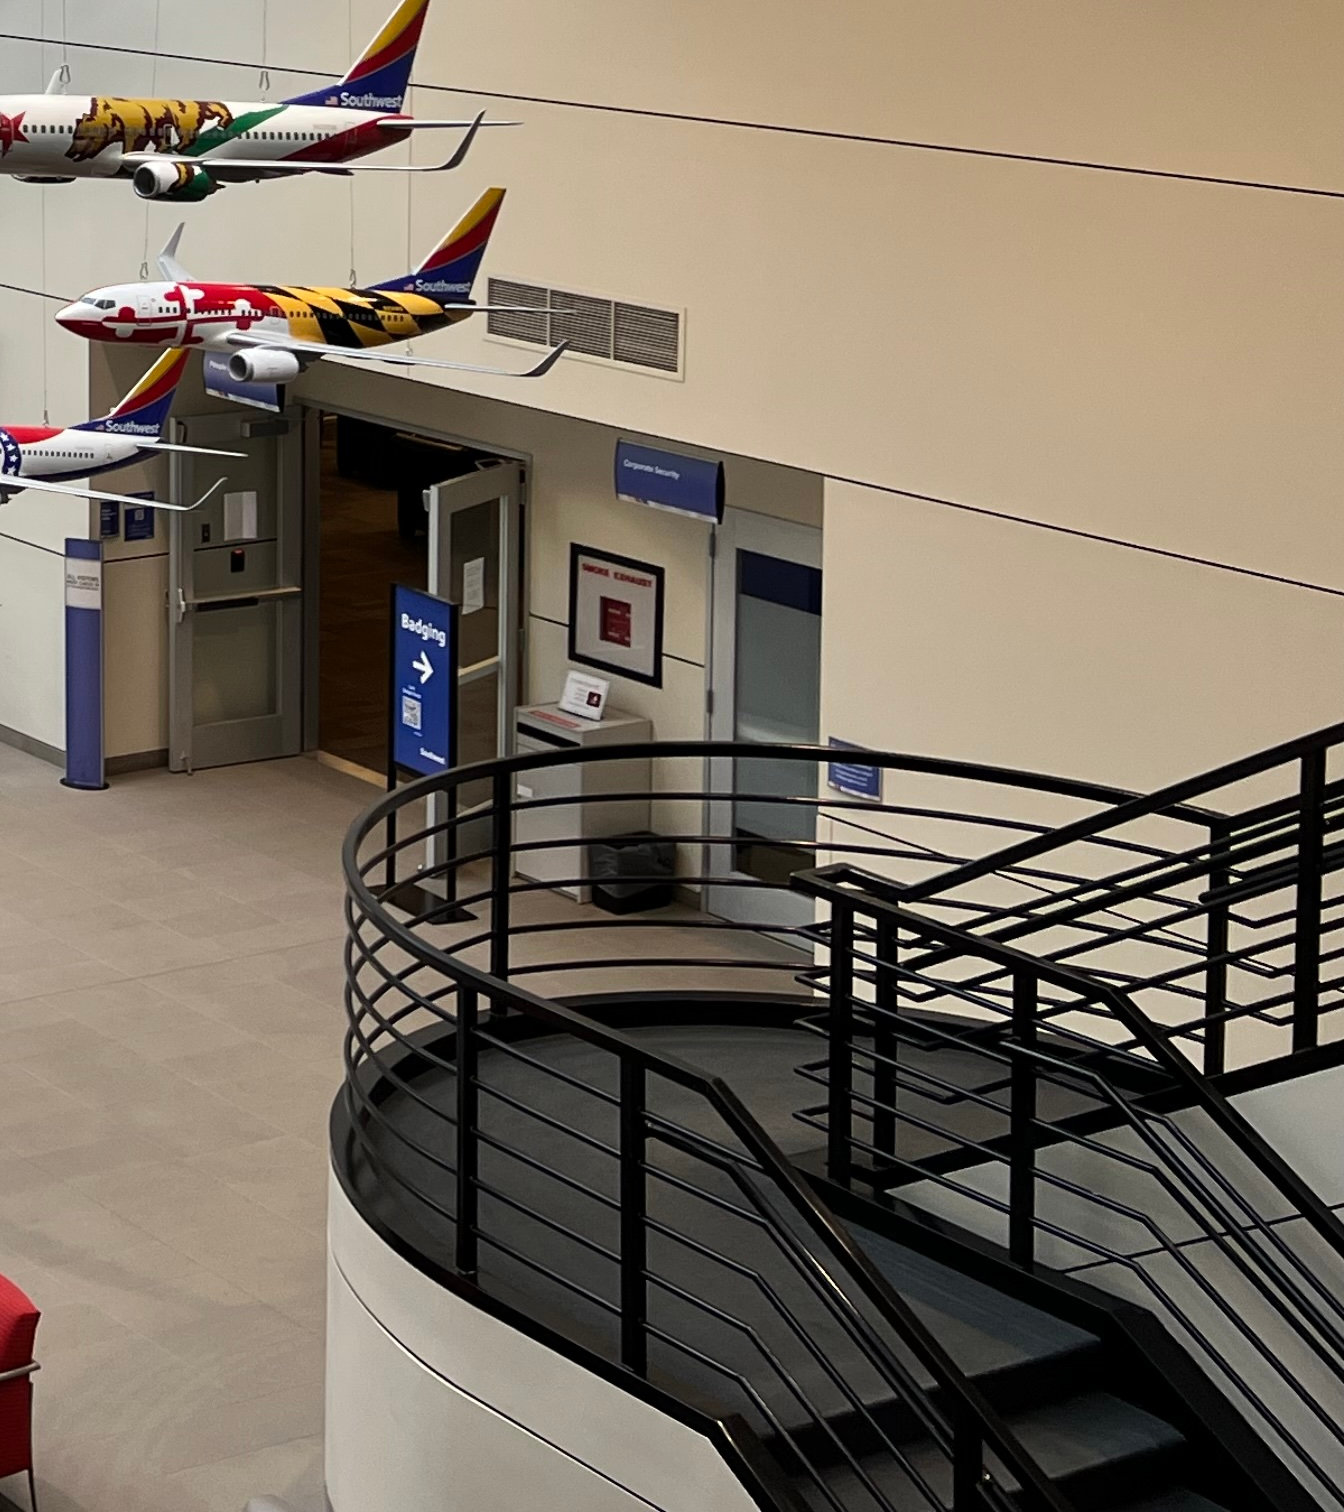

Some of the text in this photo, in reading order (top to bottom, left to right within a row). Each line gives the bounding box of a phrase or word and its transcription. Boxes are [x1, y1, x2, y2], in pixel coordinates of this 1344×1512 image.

[340, 91, 403, 108] Southwest
[415, 279, 471, 293] Southwest
[105, 420, 160, 434] Southwest
[401, 613, 446, 648] Badging
